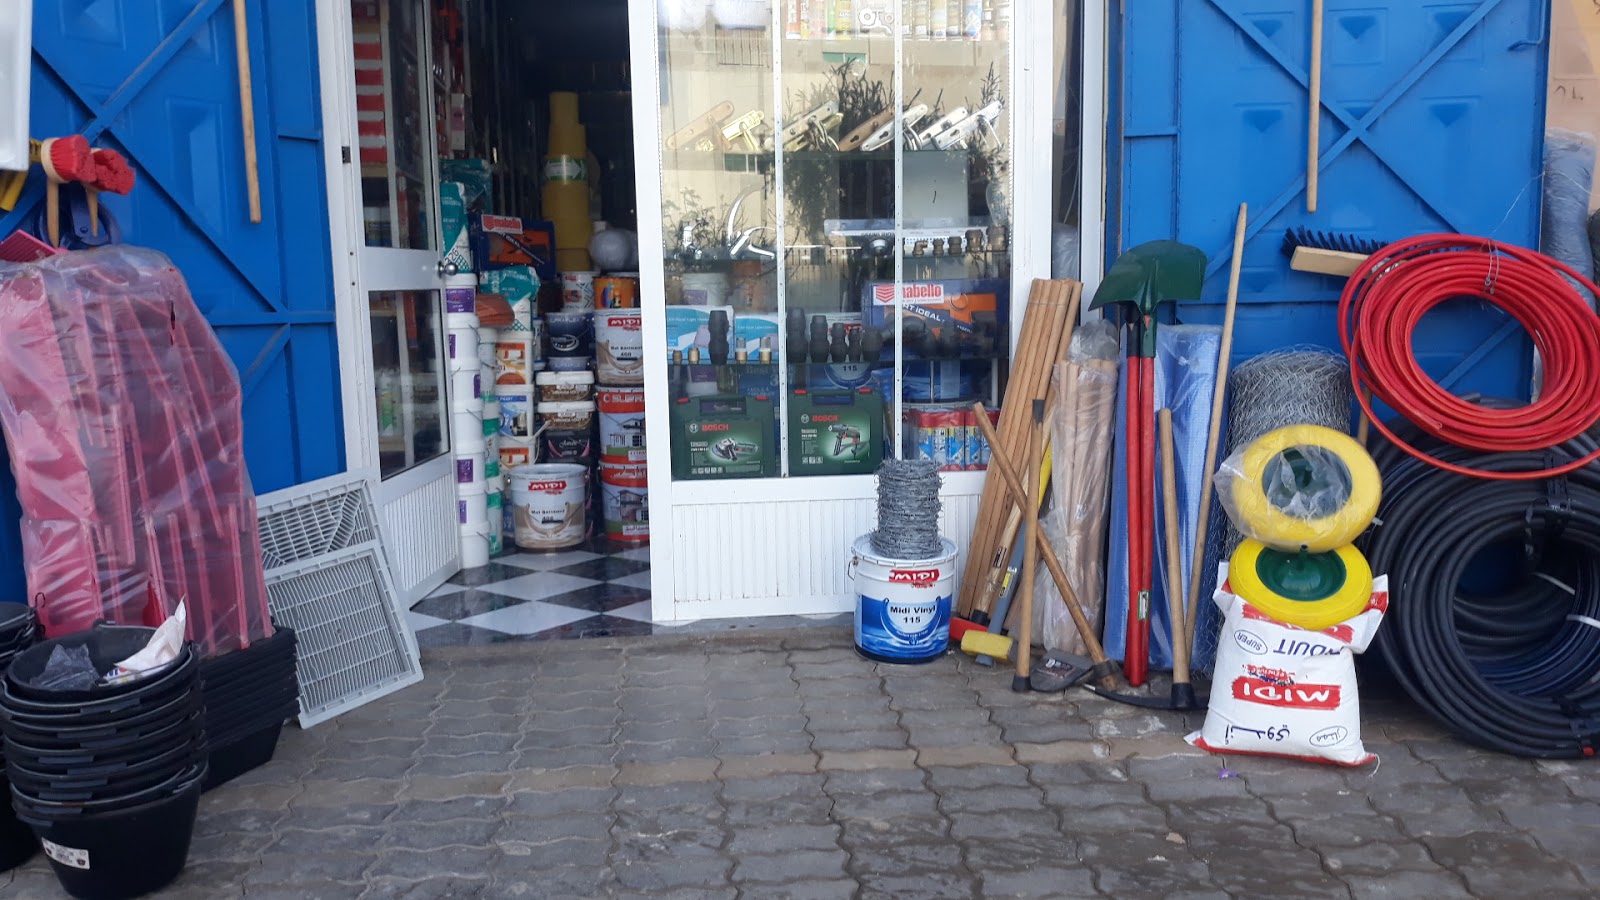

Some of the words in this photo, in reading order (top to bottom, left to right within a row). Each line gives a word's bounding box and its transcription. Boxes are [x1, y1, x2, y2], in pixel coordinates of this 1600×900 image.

[532, 482, 563, 490] MIDI
[894, 571, 935, 580] MIDI
[890, 606, 910, 614] Midi
[914, 605, 936, 615] Vinyl
[1237, 632, 1262, 651] SUPER
[1243, 682, 1330, 702] MIDI
